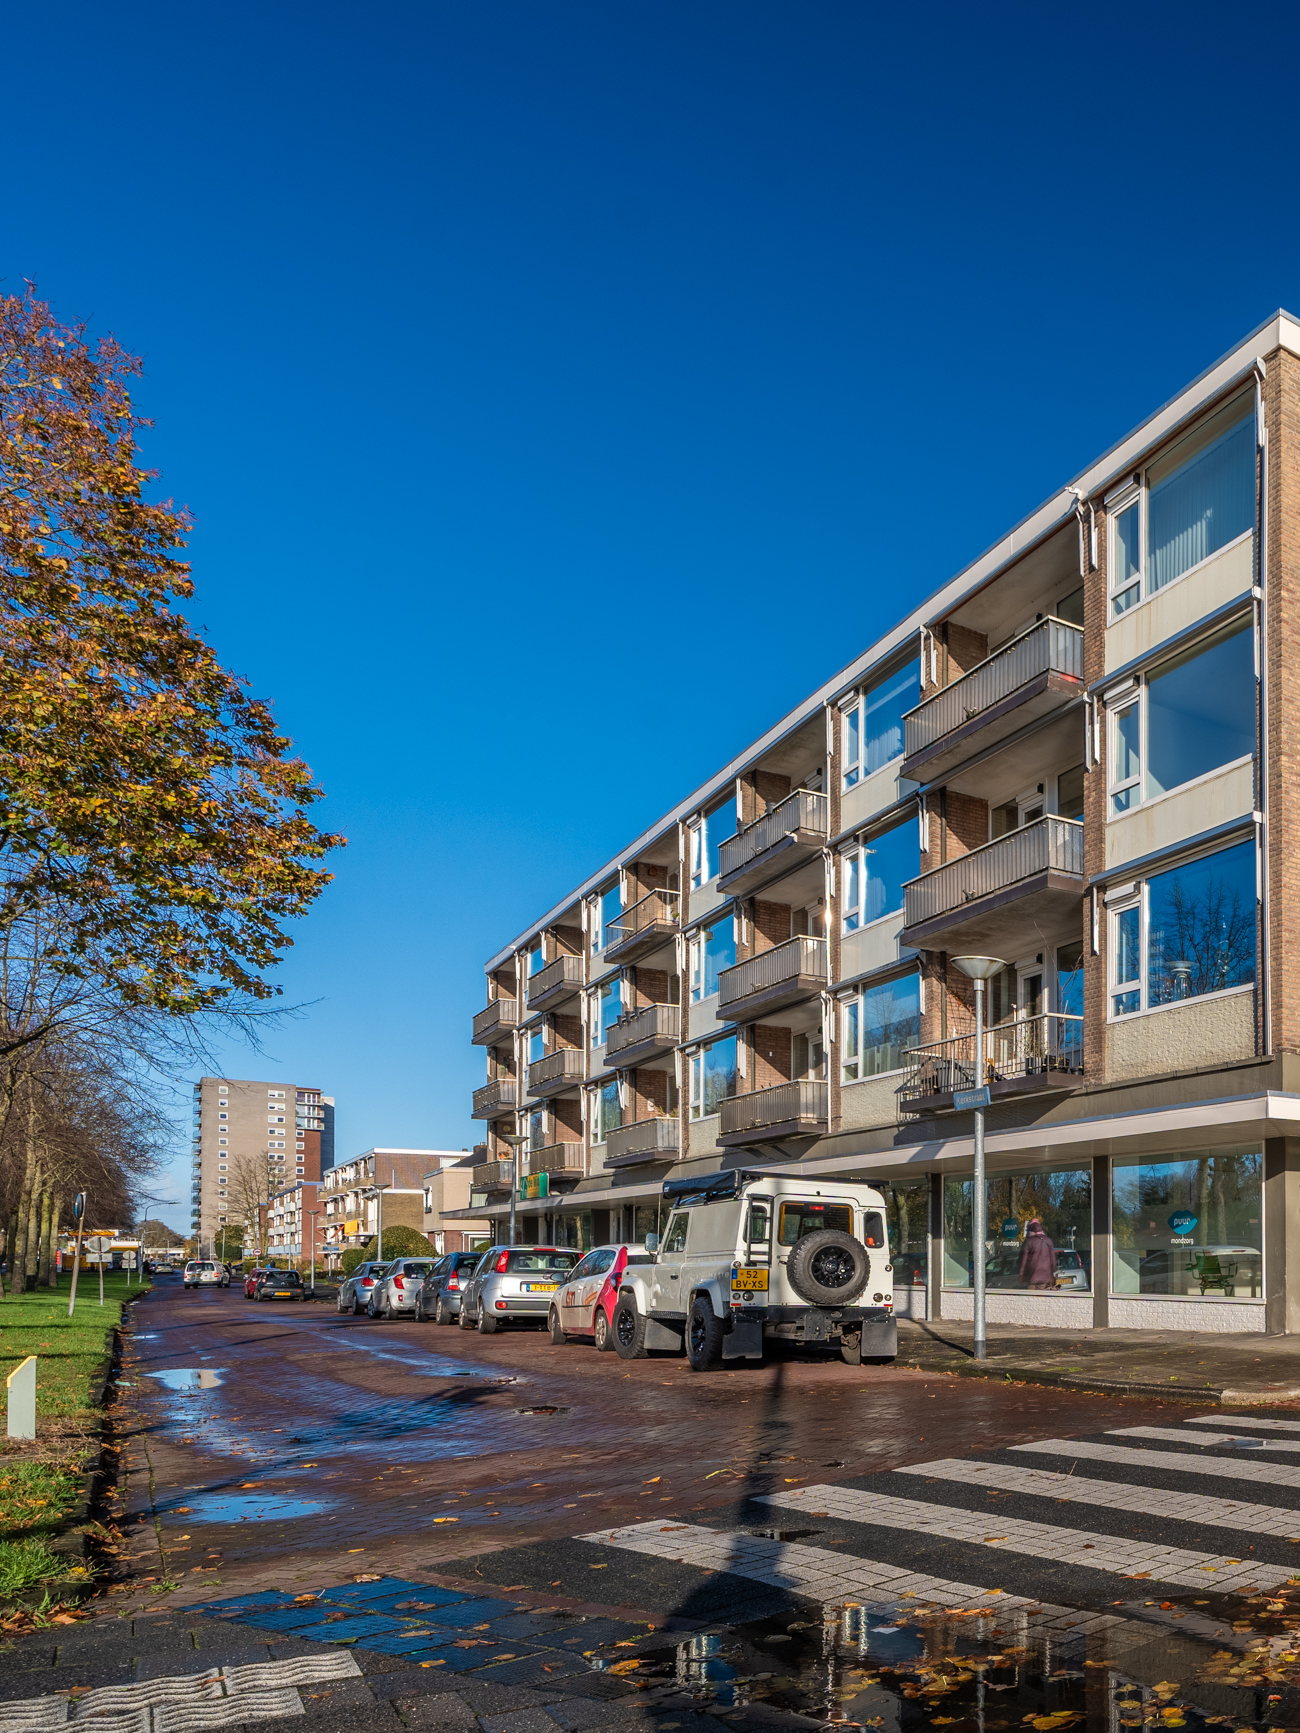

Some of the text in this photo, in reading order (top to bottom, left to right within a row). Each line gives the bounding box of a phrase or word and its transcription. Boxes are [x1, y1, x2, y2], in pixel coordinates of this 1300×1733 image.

[957, 1093, 986, 1105] Kerkstraat
[1173, 1217, 1191, 1226] puur
[1004, 1224, 1018, 1232] puur
[1002, 1240, 1020, 1248] mondzorg
[1170, 1237, 1194, 1245] mondzorg
[746, 1271, 758, 1279] 52
[735, 1280, 764, 1289] BV-XS
